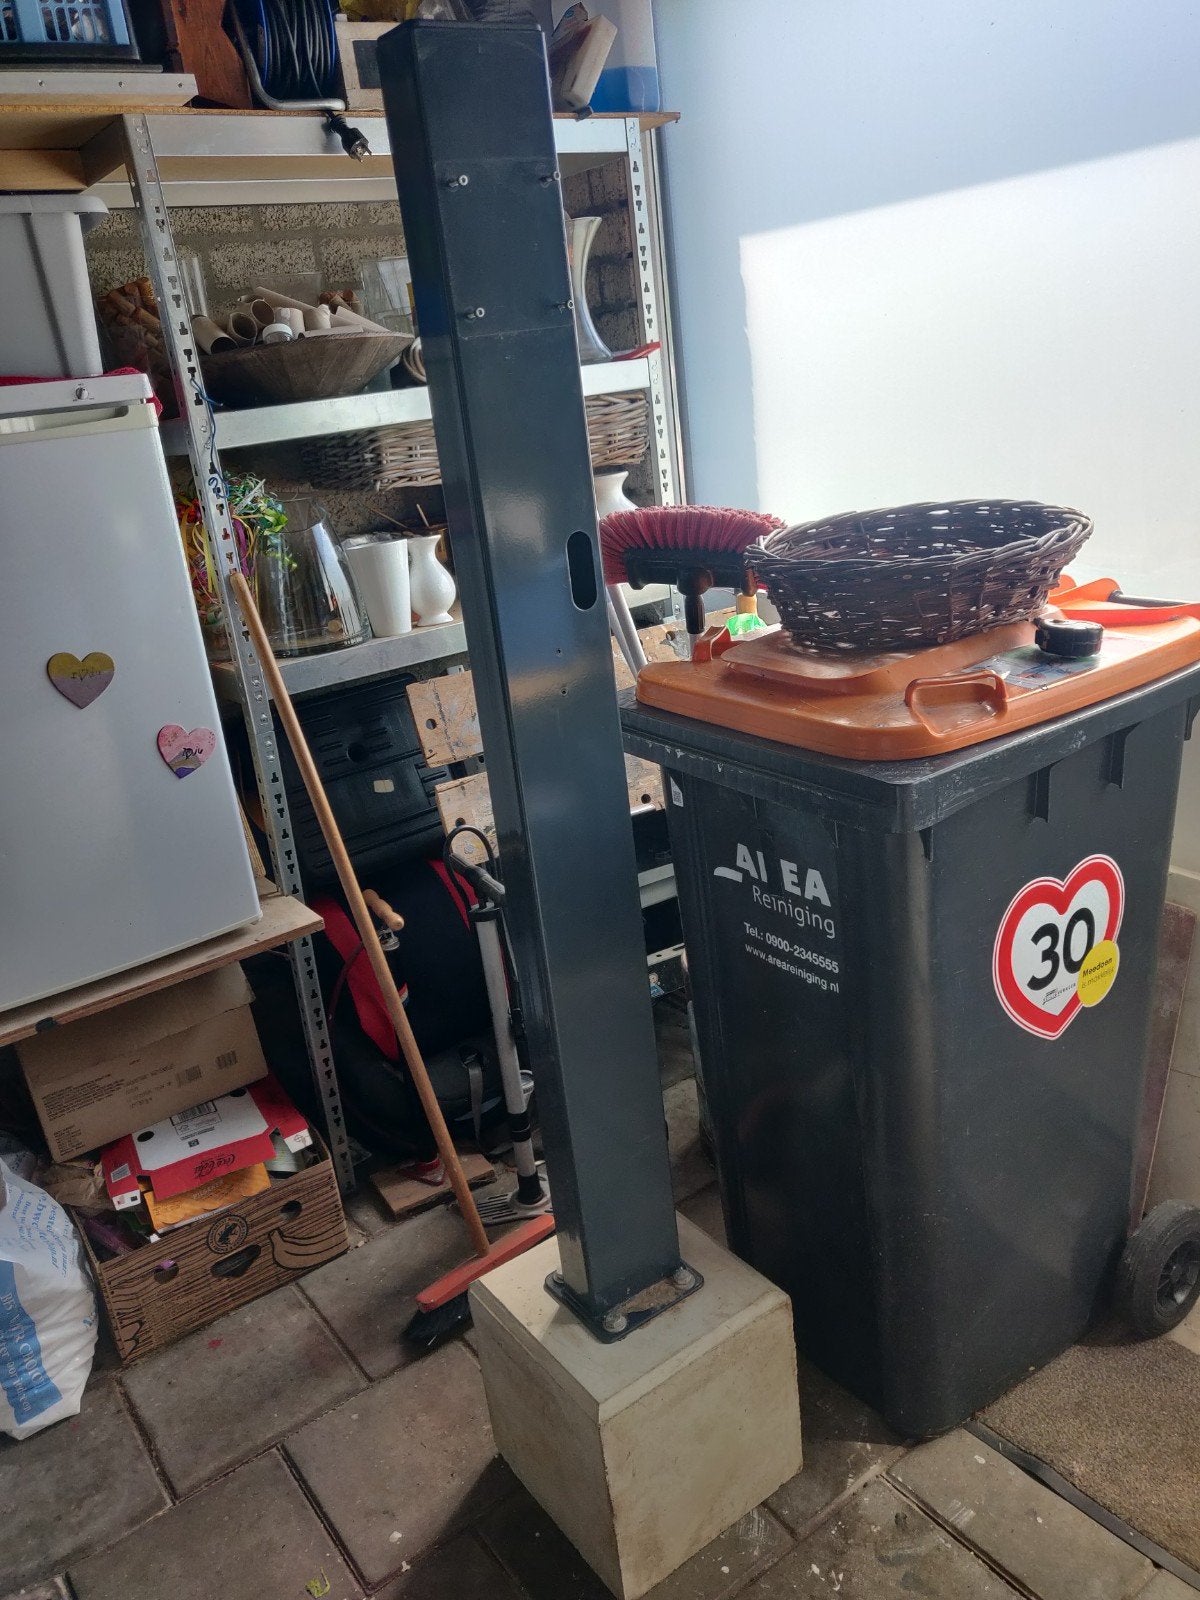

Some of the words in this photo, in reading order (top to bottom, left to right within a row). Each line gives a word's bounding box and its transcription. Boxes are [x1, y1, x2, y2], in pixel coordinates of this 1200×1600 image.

[752, 885, 835, 939] Reiniging
[744, 921, 764, 941] Tel.:
[765, 932, 839, 974] 0900-2345555
[1027, 907, 1095, 991] 30
[1082, 957, 1113, 978] Meedoen
